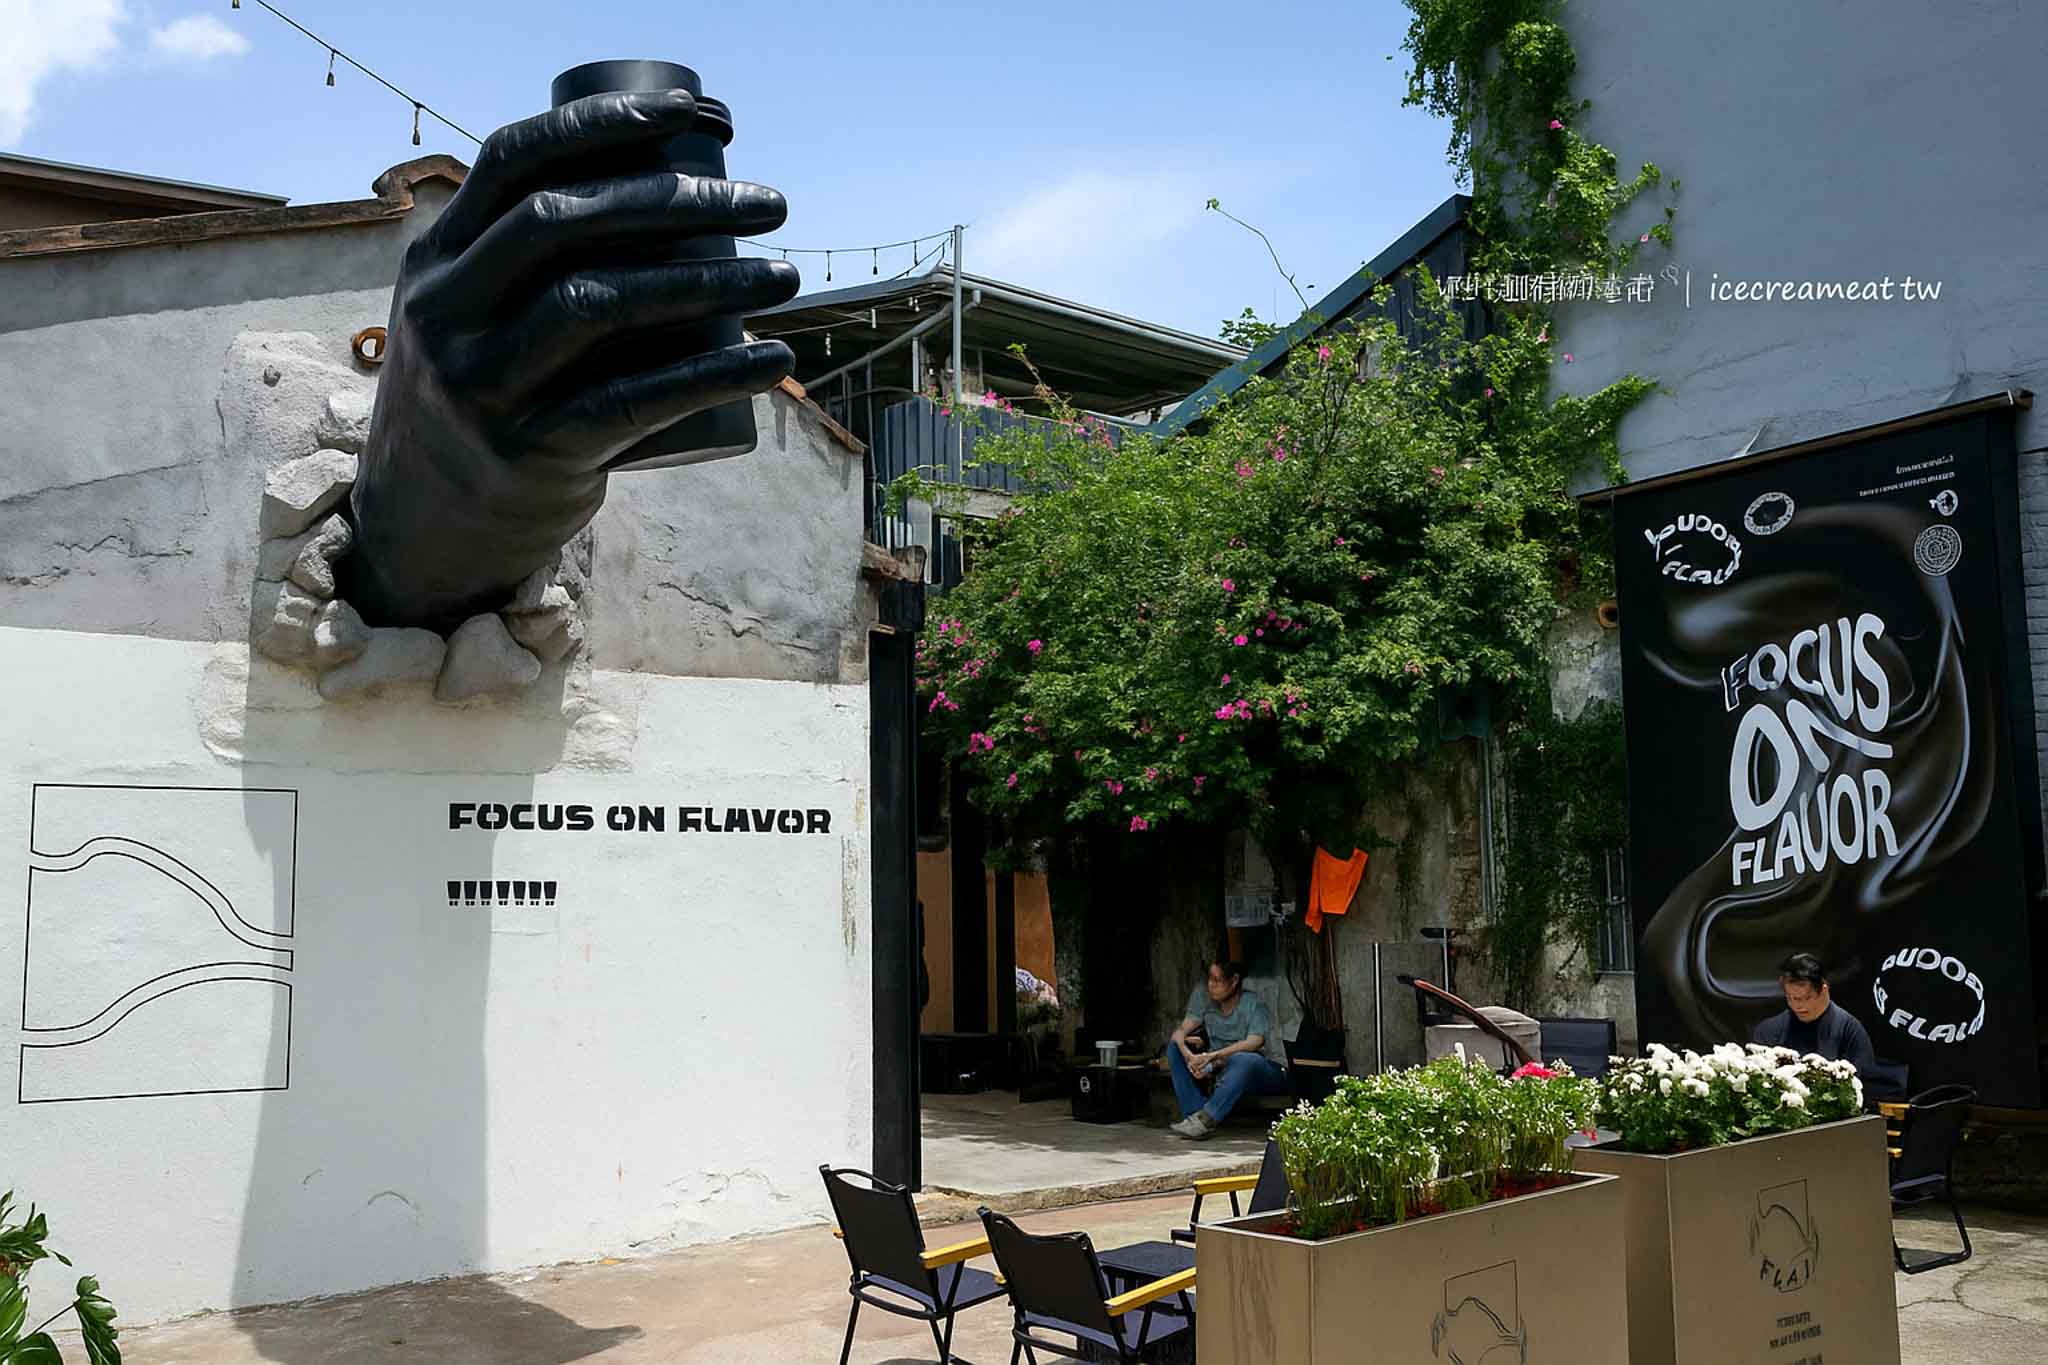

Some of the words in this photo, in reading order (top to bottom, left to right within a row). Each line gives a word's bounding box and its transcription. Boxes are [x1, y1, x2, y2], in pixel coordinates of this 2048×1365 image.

[1721, 613, 1890, 732] FOCUS
[449, 803, 593, 830] FOCUS
[606, 805, 665, 832] ON
[678, 806, 831, 834] FLAVOR
[1730, 699, 1893, 831] ON
[1733, 768, 1900, 886] FLAVOR
